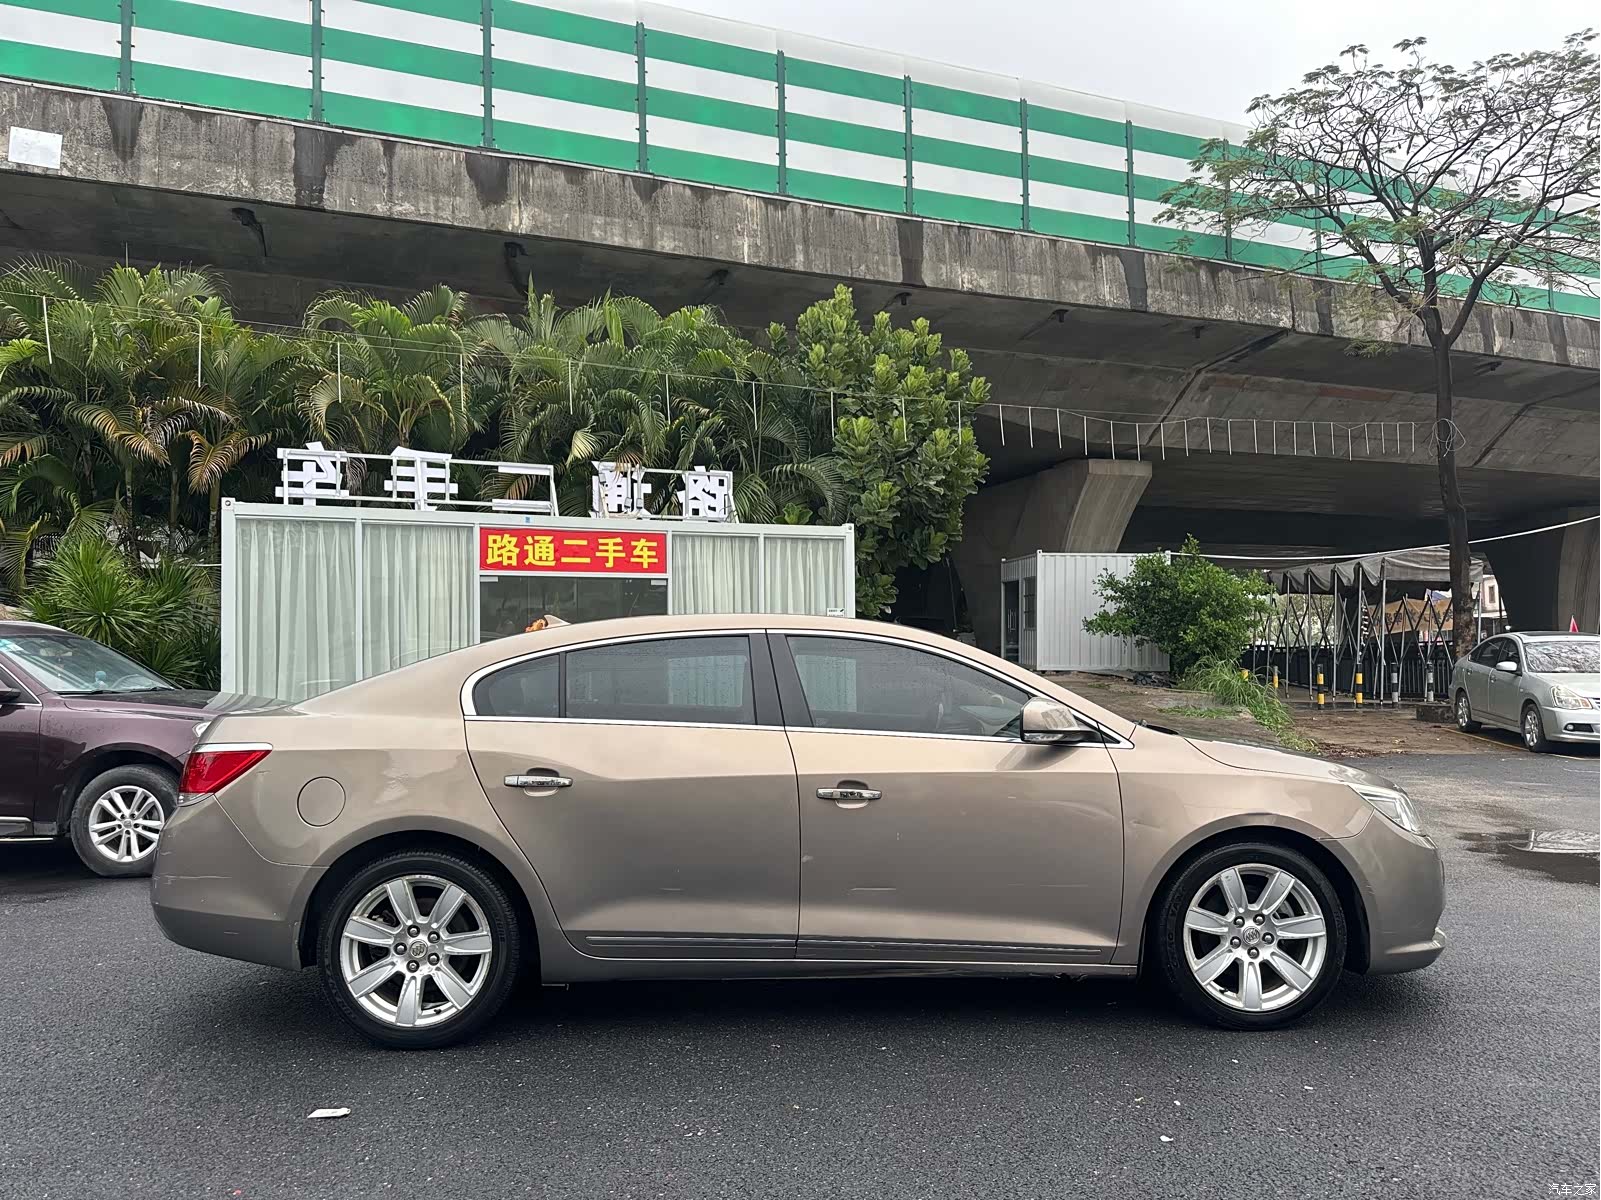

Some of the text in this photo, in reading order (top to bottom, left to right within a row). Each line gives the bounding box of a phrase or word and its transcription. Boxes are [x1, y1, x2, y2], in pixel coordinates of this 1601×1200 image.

[486, 533, 659, 569] 路通二手车
